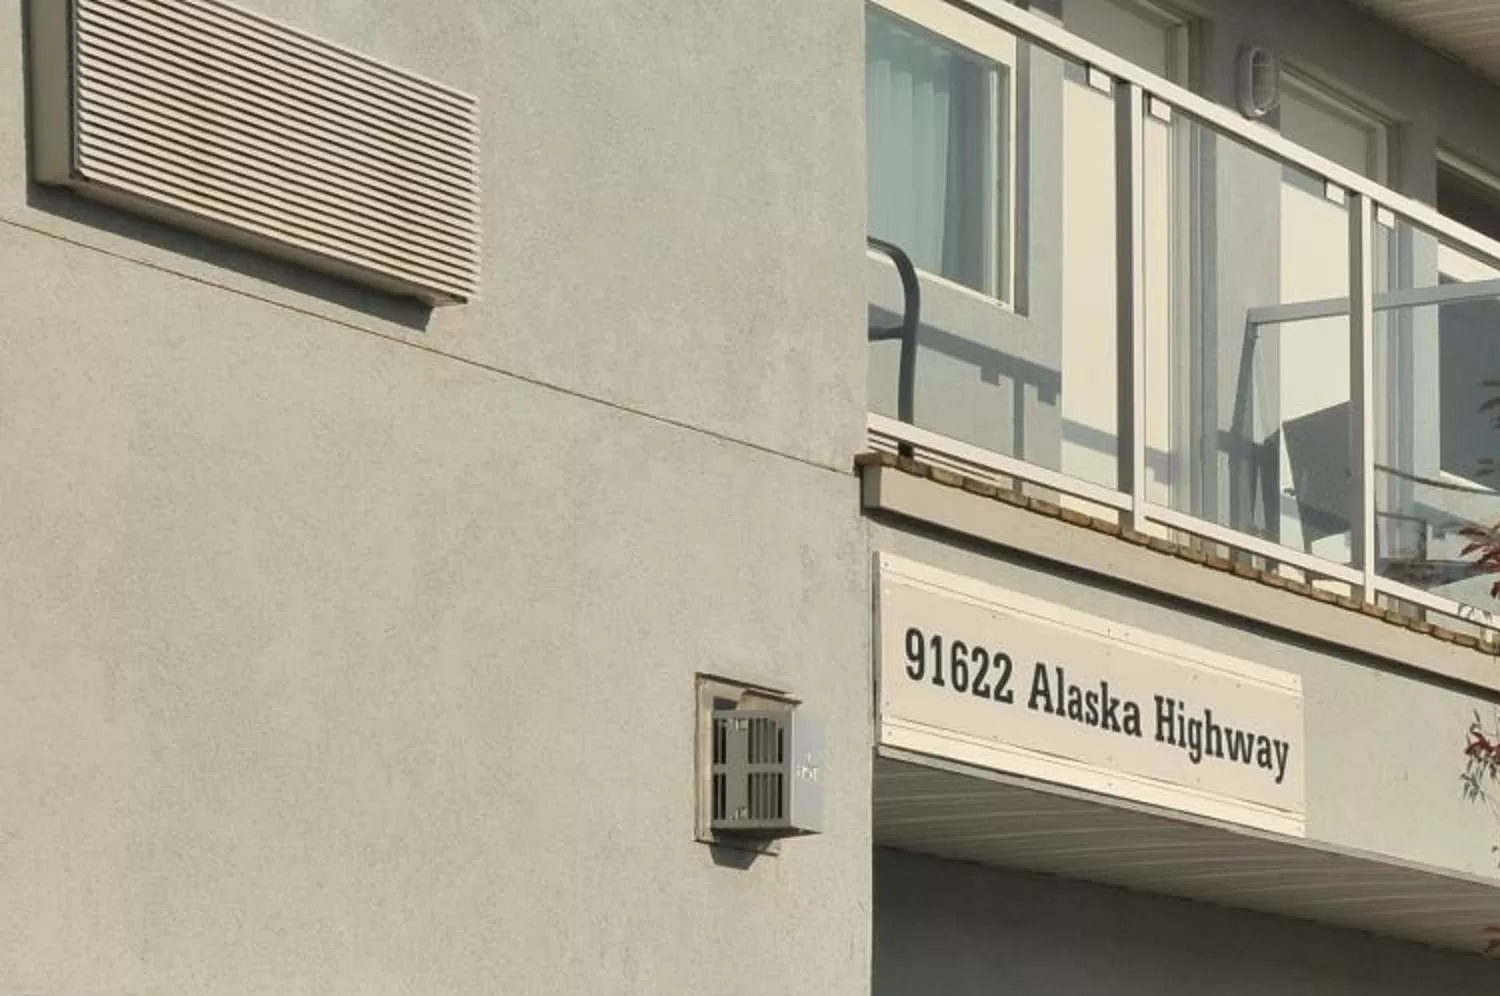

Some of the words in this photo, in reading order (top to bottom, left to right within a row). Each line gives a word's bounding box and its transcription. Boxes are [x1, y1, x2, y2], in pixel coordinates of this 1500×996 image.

[905, 627, 1014, 704] 91622
[1028, 662, 1142, 737] Alaska
[1155, 695, 1290, 784] Highway
